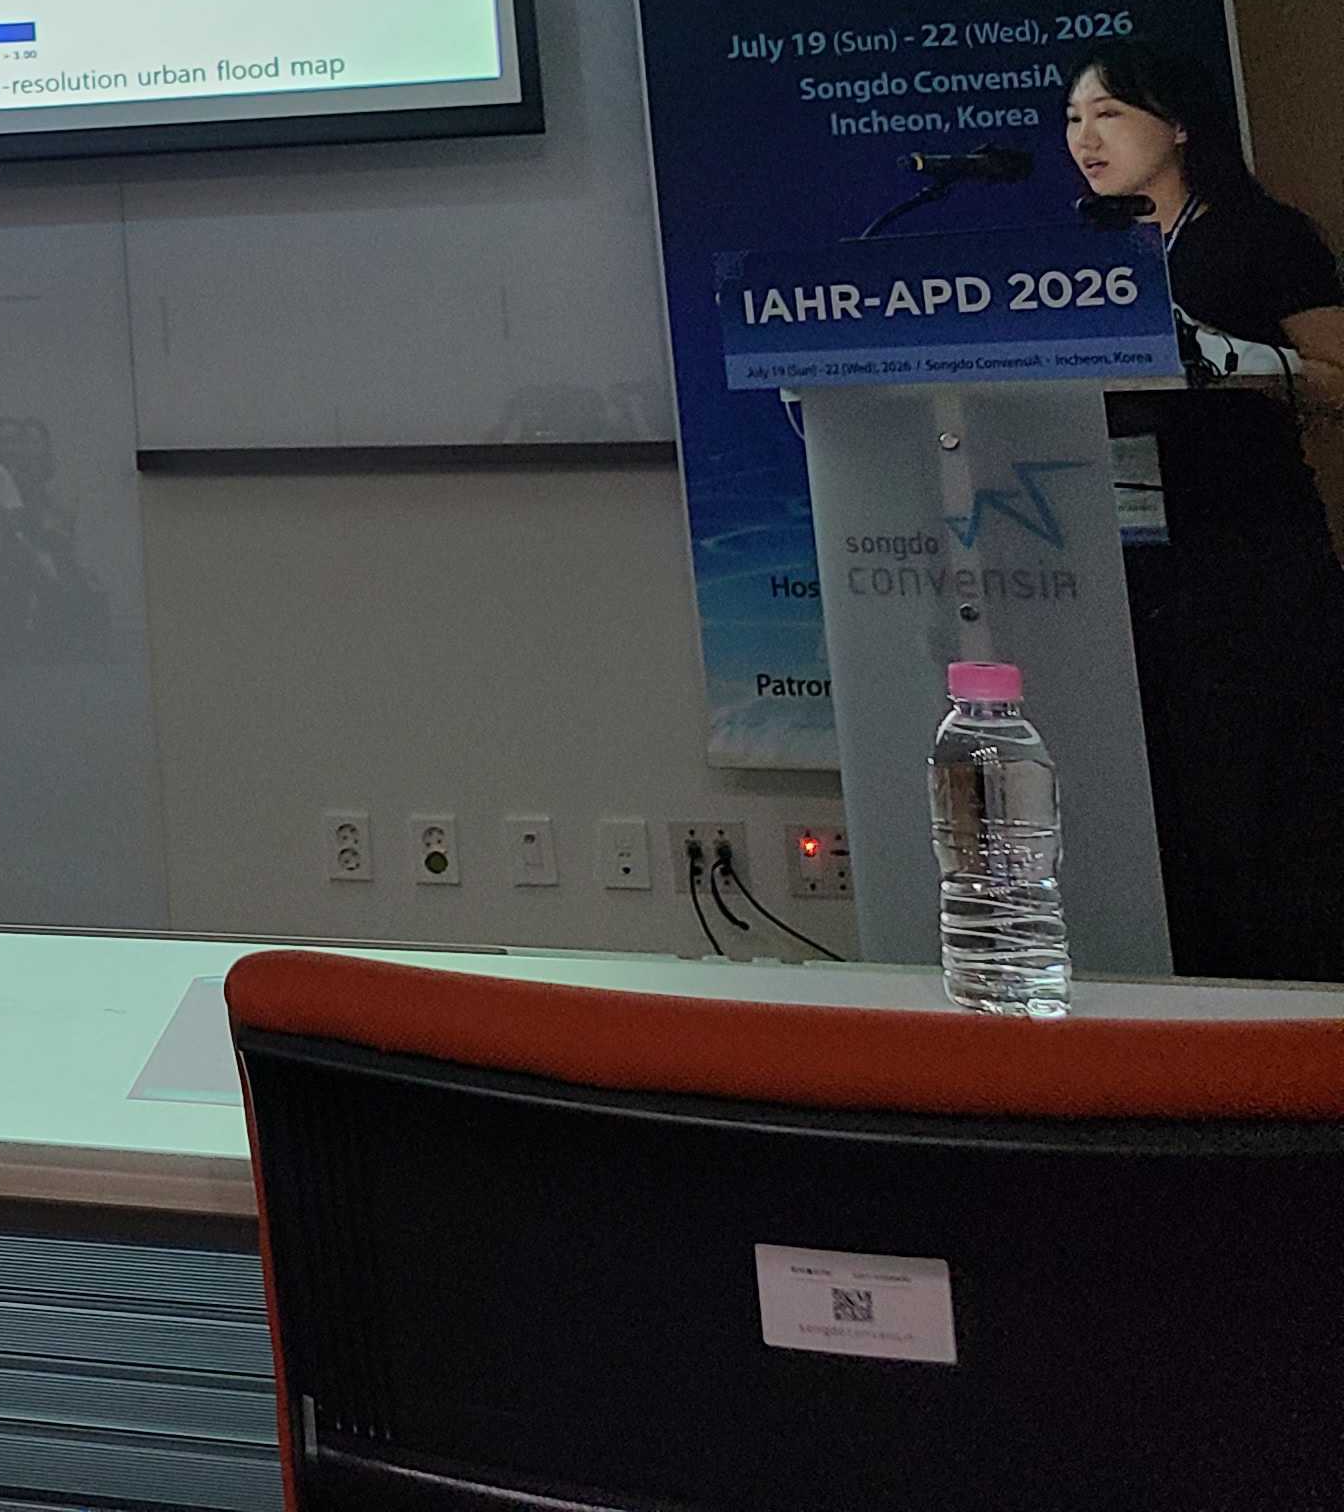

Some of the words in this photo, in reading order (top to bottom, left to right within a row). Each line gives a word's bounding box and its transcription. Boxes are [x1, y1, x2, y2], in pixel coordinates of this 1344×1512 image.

[727, 33, 784, 64] July
[791, 31, 826, 56] 19
[833, 28, 897, 56] (Sun)
[921, 23, 959, 48] 22
[965, 19, 1049, 49] (Wed),
[1055, 10, 1133, 40] 2026
[137, 64, 207, 87] urban
[216, 56, 280, 81] flood
[290, 57, 346, 81] map
[799, 71, 908, 103] Songdo
[913, 63, 1063, 93] ConvensiA
[830, 109, 951, 136] Incheon,
[956, 105, 1039, 129] Korea
[743, 276, 992, 325] IAHR-APD
[1008, 266, 1138, 311] 2026
[845, 531, 939, 561] songdo
[770, 575, 822, 598] Hos
